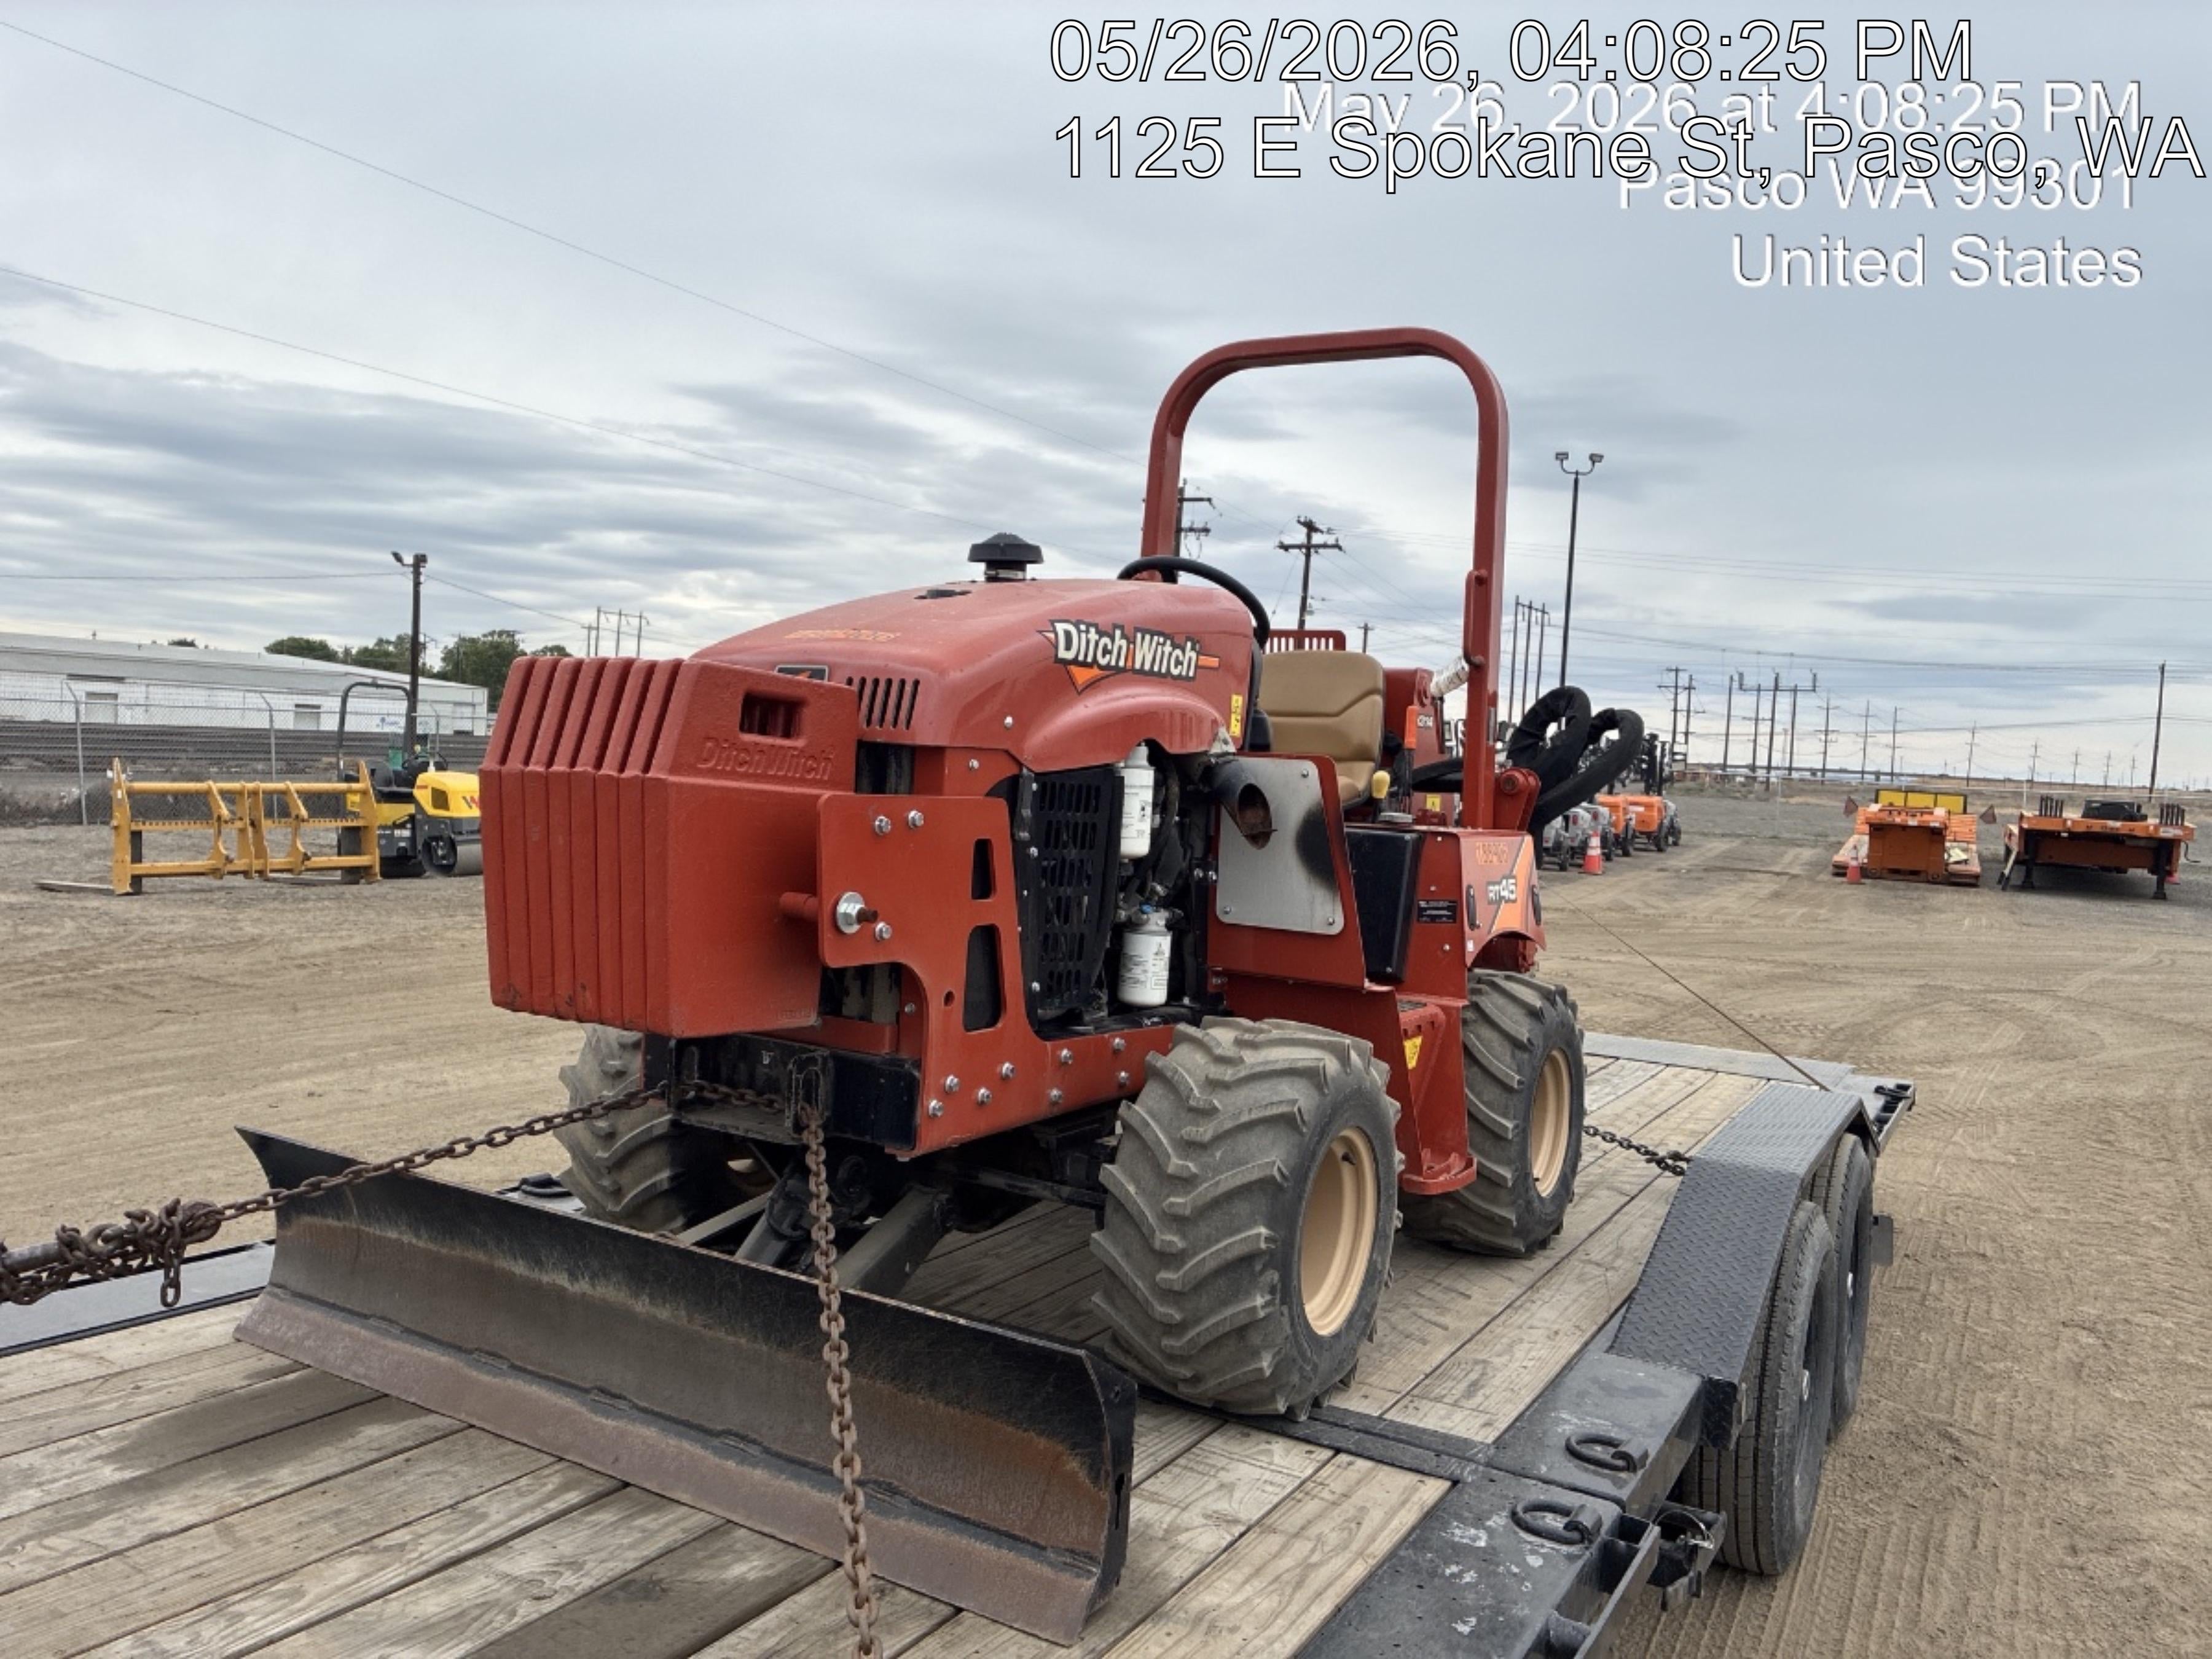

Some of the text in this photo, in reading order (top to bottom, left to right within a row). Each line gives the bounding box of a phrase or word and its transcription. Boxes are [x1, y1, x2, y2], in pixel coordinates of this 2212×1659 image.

[1053, 621, 1198, 678] Ditch Witch
[697, 737, 834, 780] Ditch Witch
[1488, 878, 1516, 901] RT45
